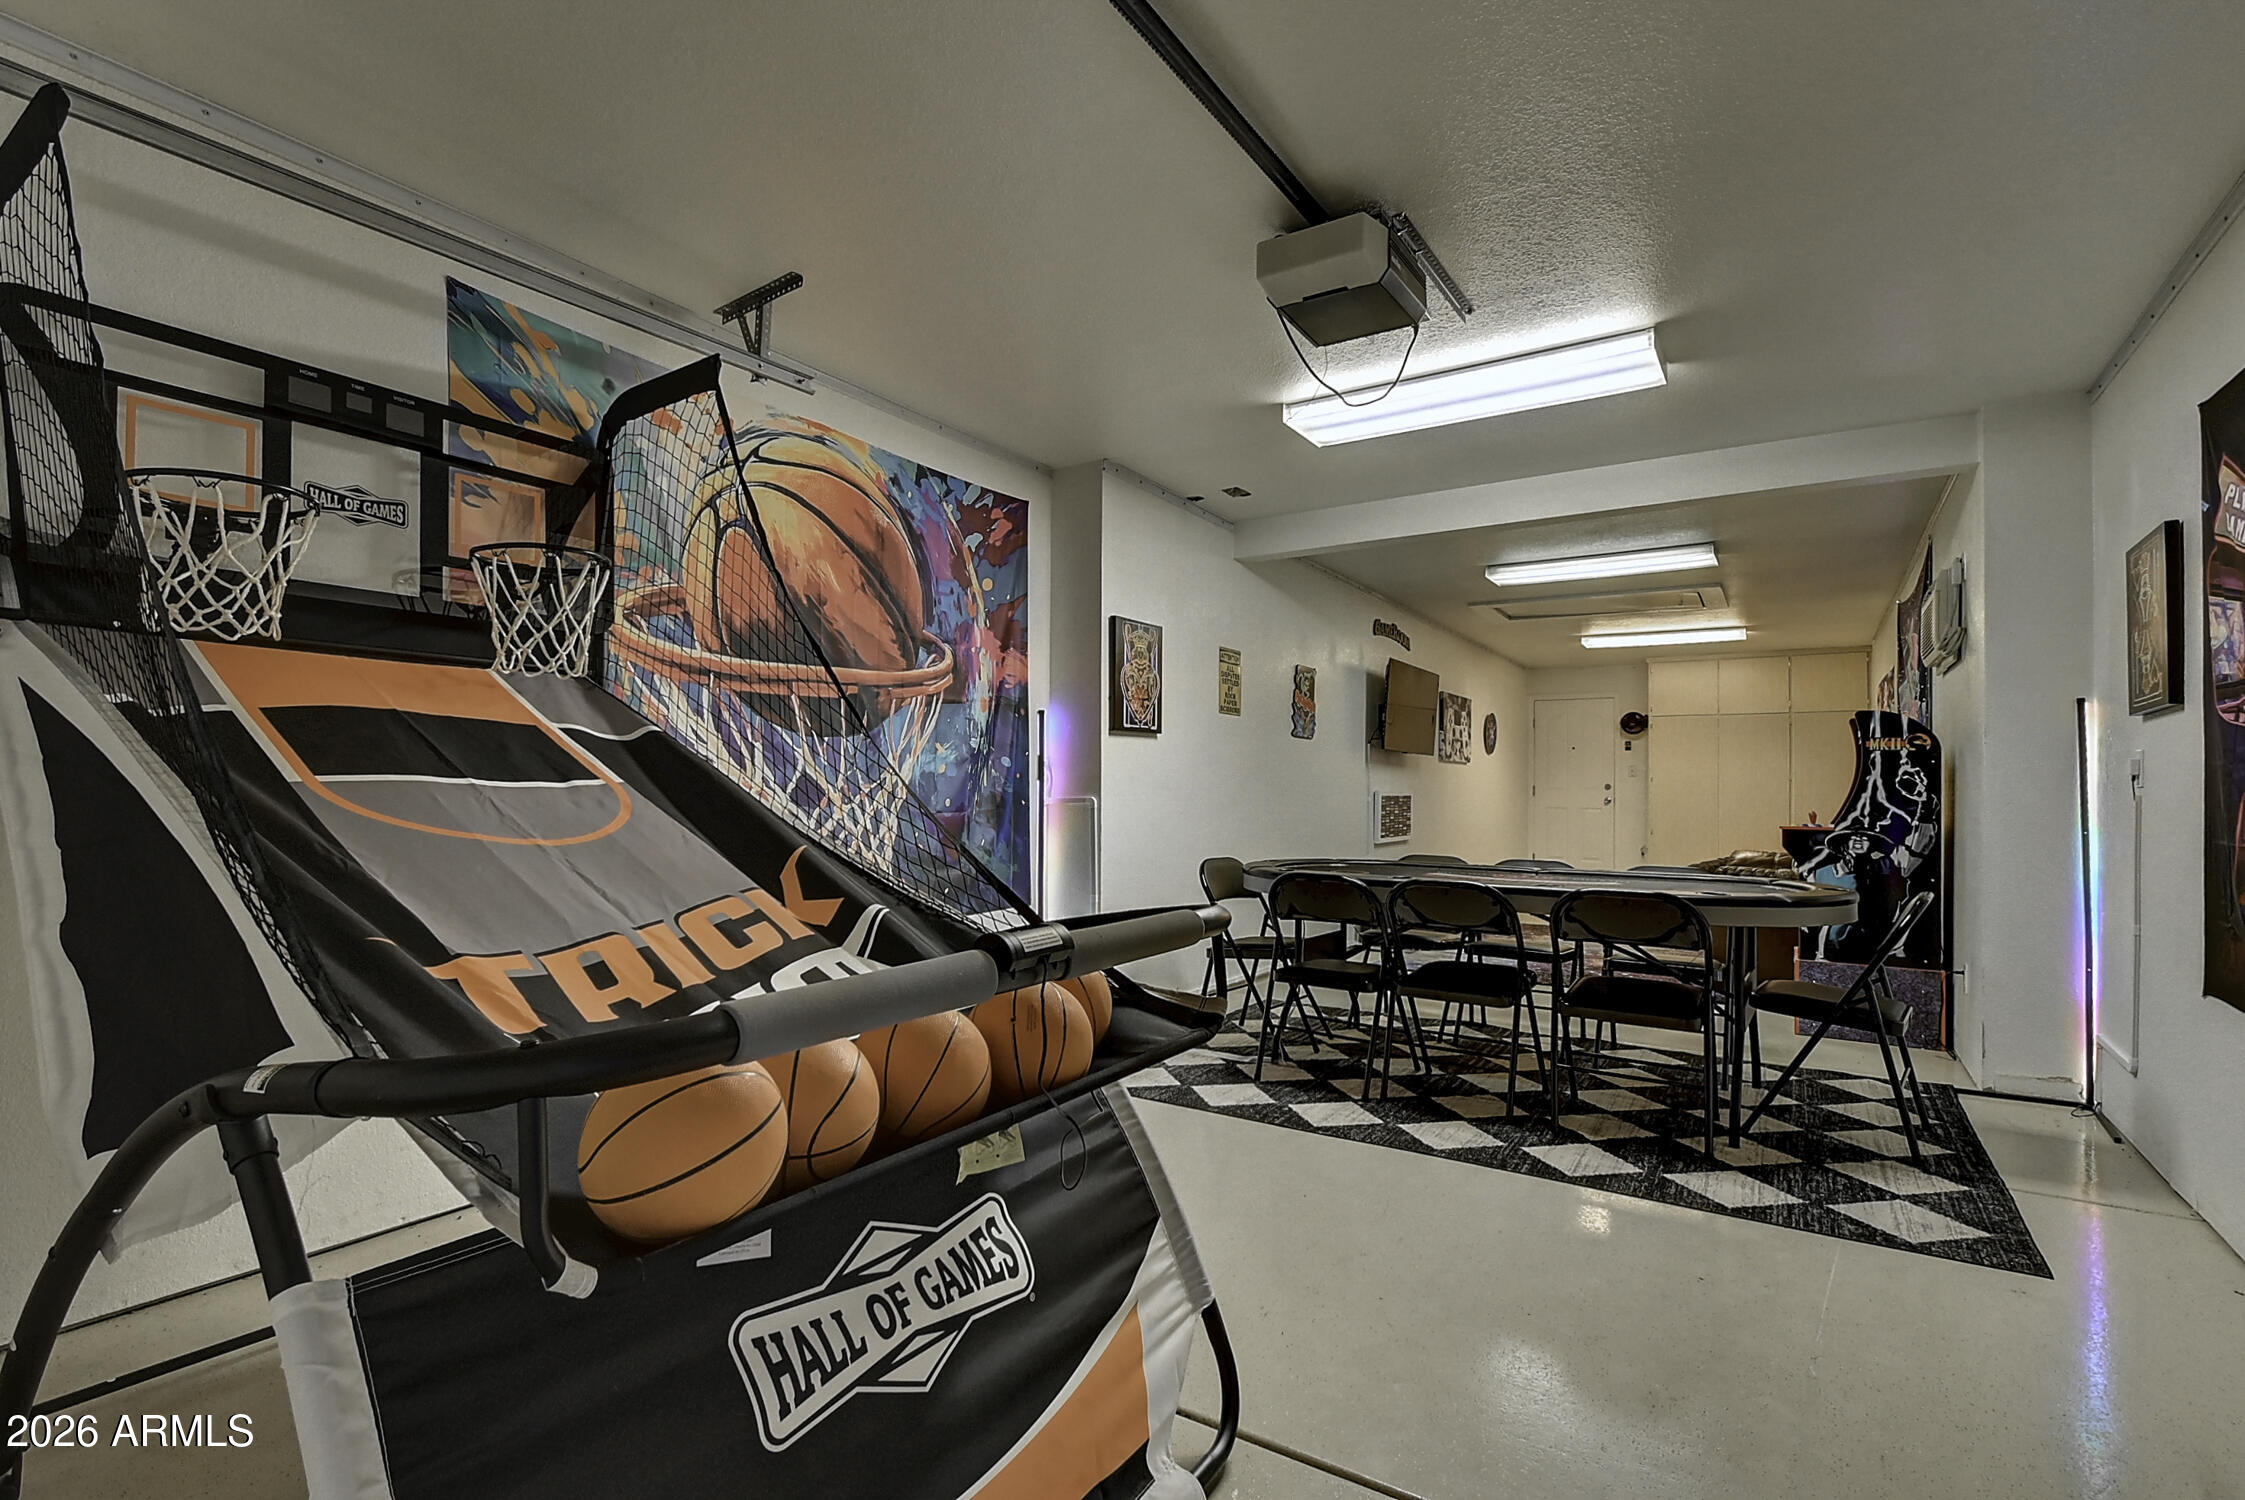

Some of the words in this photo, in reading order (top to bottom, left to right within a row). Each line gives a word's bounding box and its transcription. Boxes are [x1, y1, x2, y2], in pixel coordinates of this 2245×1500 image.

[299, 369, 318, 378] HOME
[351, 383, 366, 391] TIME
[309, 486, 342, 509] HALL
[344, 498, 361, 512] OF
[363, 502, 404, 524] GAMES
[423, 845, 844, 1034] TRICK
[751, 1309, 868, 1422] HALL
[865, 1281, 912, 1340] OF
[913, 1216, 1020, 1310] GAMES
